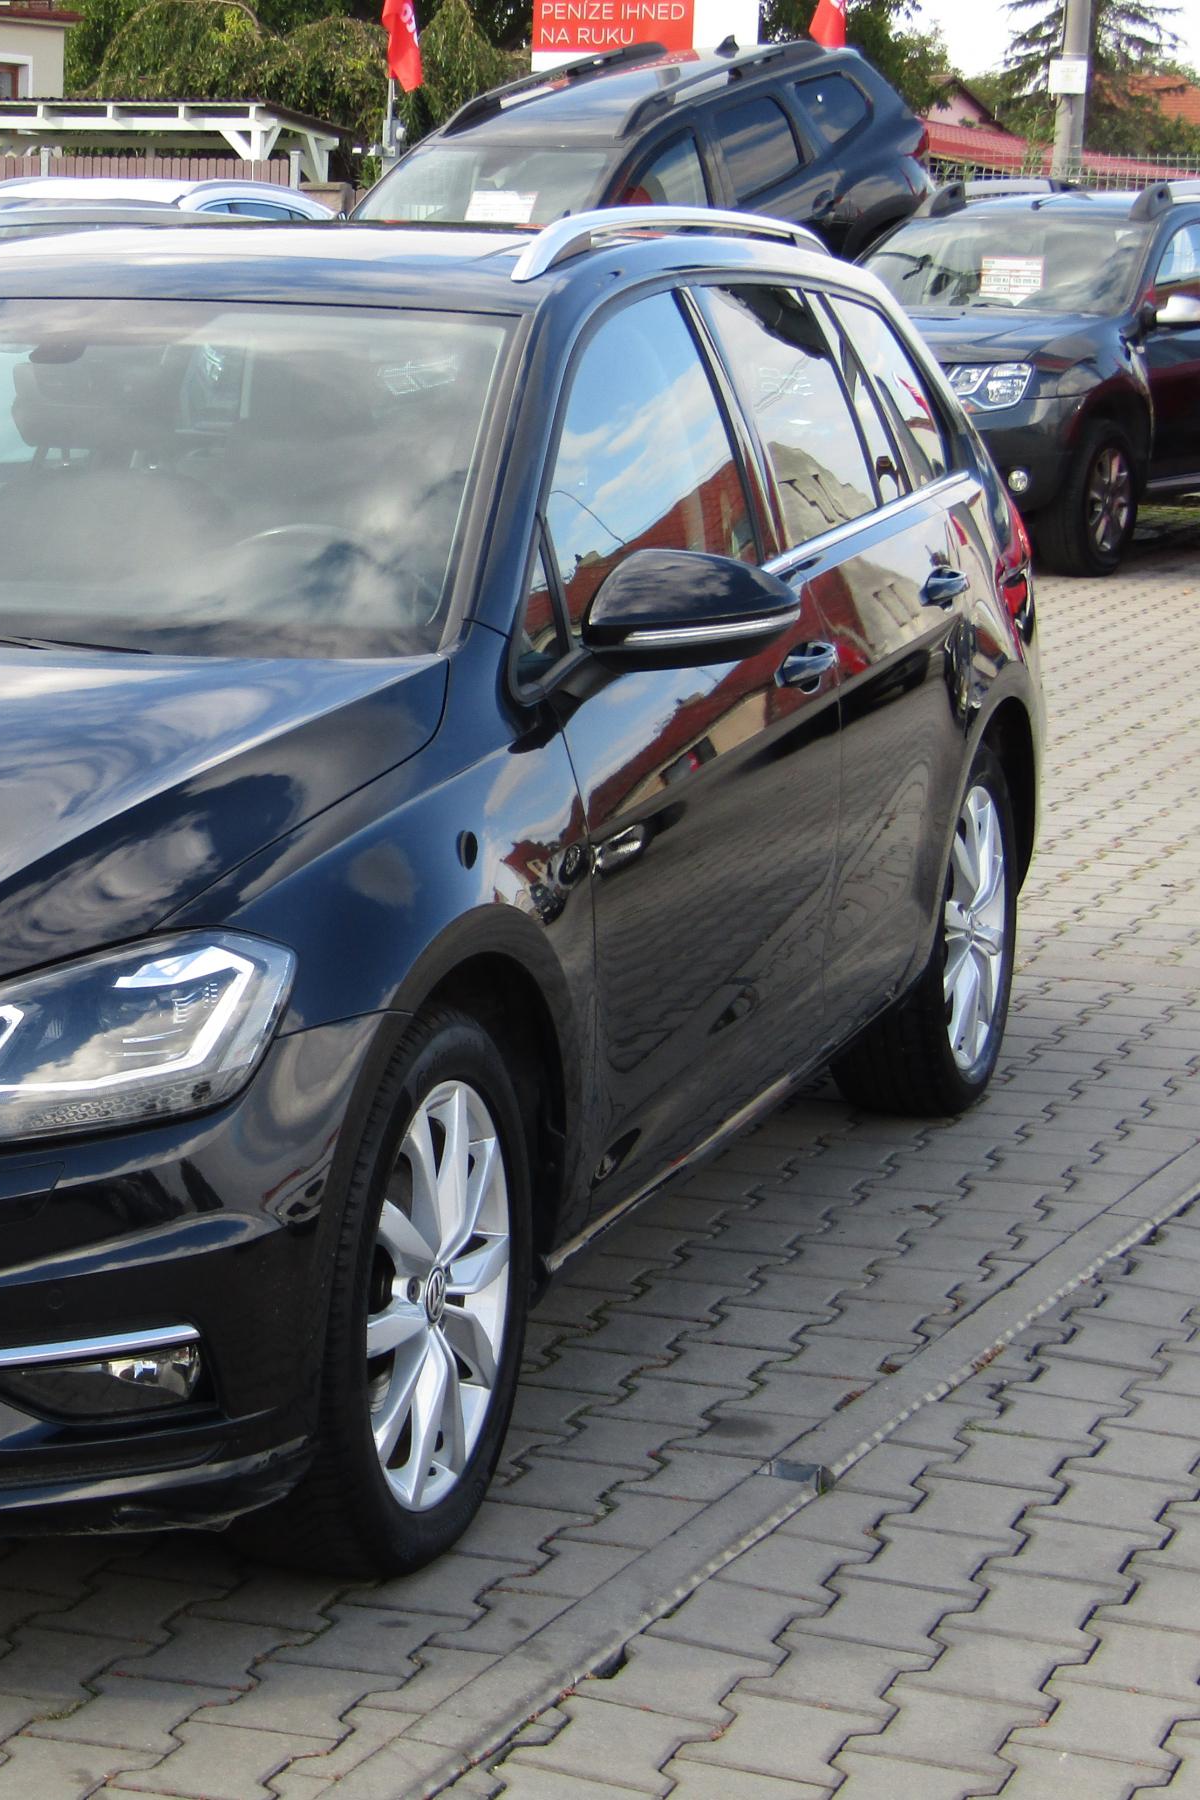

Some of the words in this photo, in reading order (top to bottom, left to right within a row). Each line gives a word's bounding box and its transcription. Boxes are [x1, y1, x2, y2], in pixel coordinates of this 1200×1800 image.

[541, 0, 614, 20] PENÍZE
[621, 3, 685, 20] IHNED
[540, 27, 570, 44] NA
[577, 27, 634, 44] RUKU
